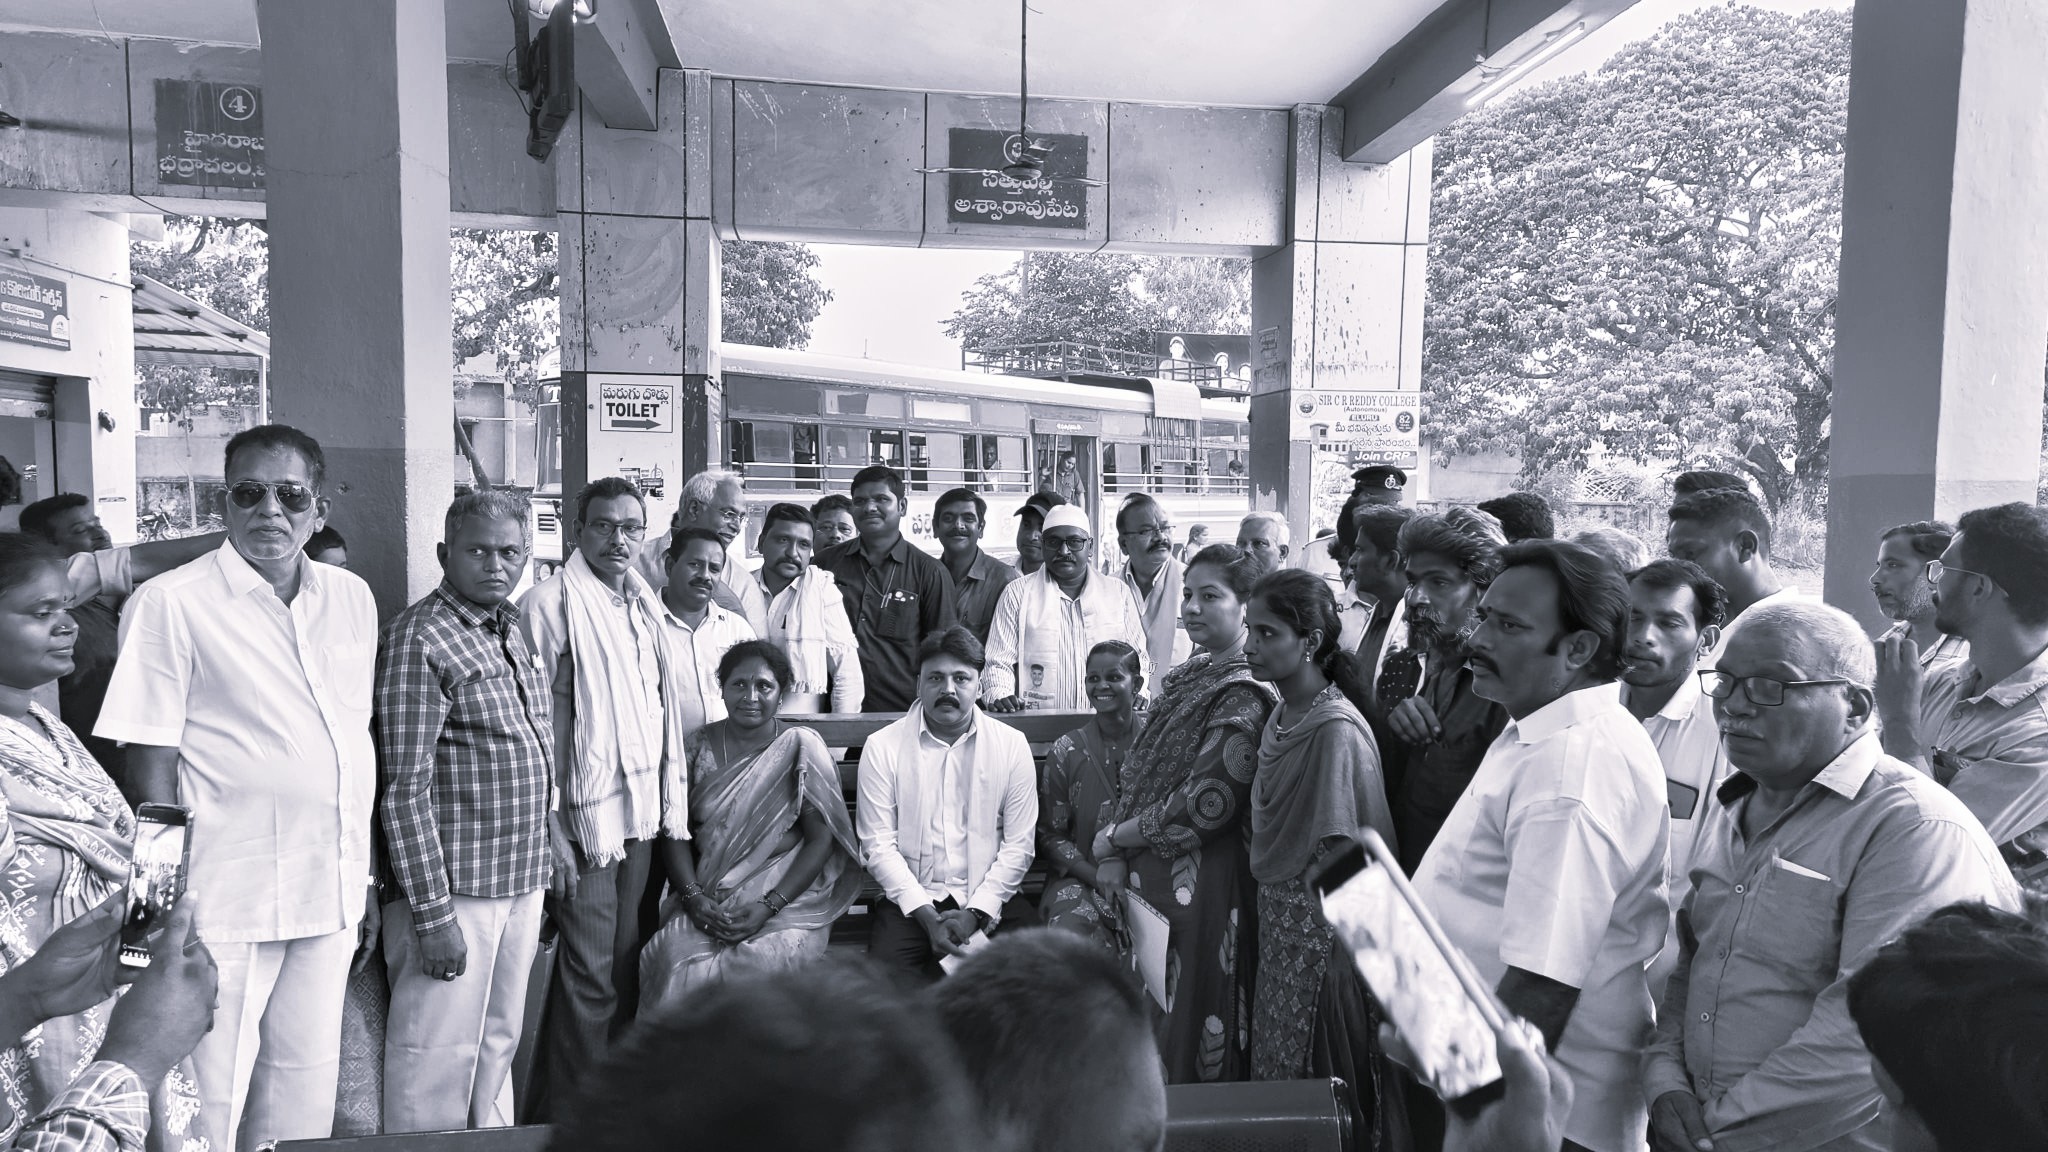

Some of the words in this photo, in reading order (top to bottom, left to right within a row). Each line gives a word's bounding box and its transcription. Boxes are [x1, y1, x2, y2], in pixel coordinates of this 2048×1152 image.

[228, 95, 248, 113] 4
[954, 198, 1079, 220] అశ్వారావుపేట
[603, 387, 640, 400] మరుగు
[1319, 395, 1333, 405] SIR
[1334, 395, 1340, 406] C
[1342, 396, 1348, 406] R
[1349, 395, 1377, 406] REDDY
[1378, 396, 1417, 407] COLLEGE
[606, 402, 660, 417] TOILET
[1399, 415, 1411, 424] 82
[1335, 421, 1346, 433] మీ
[1354, 451, 1381, 461] Join
